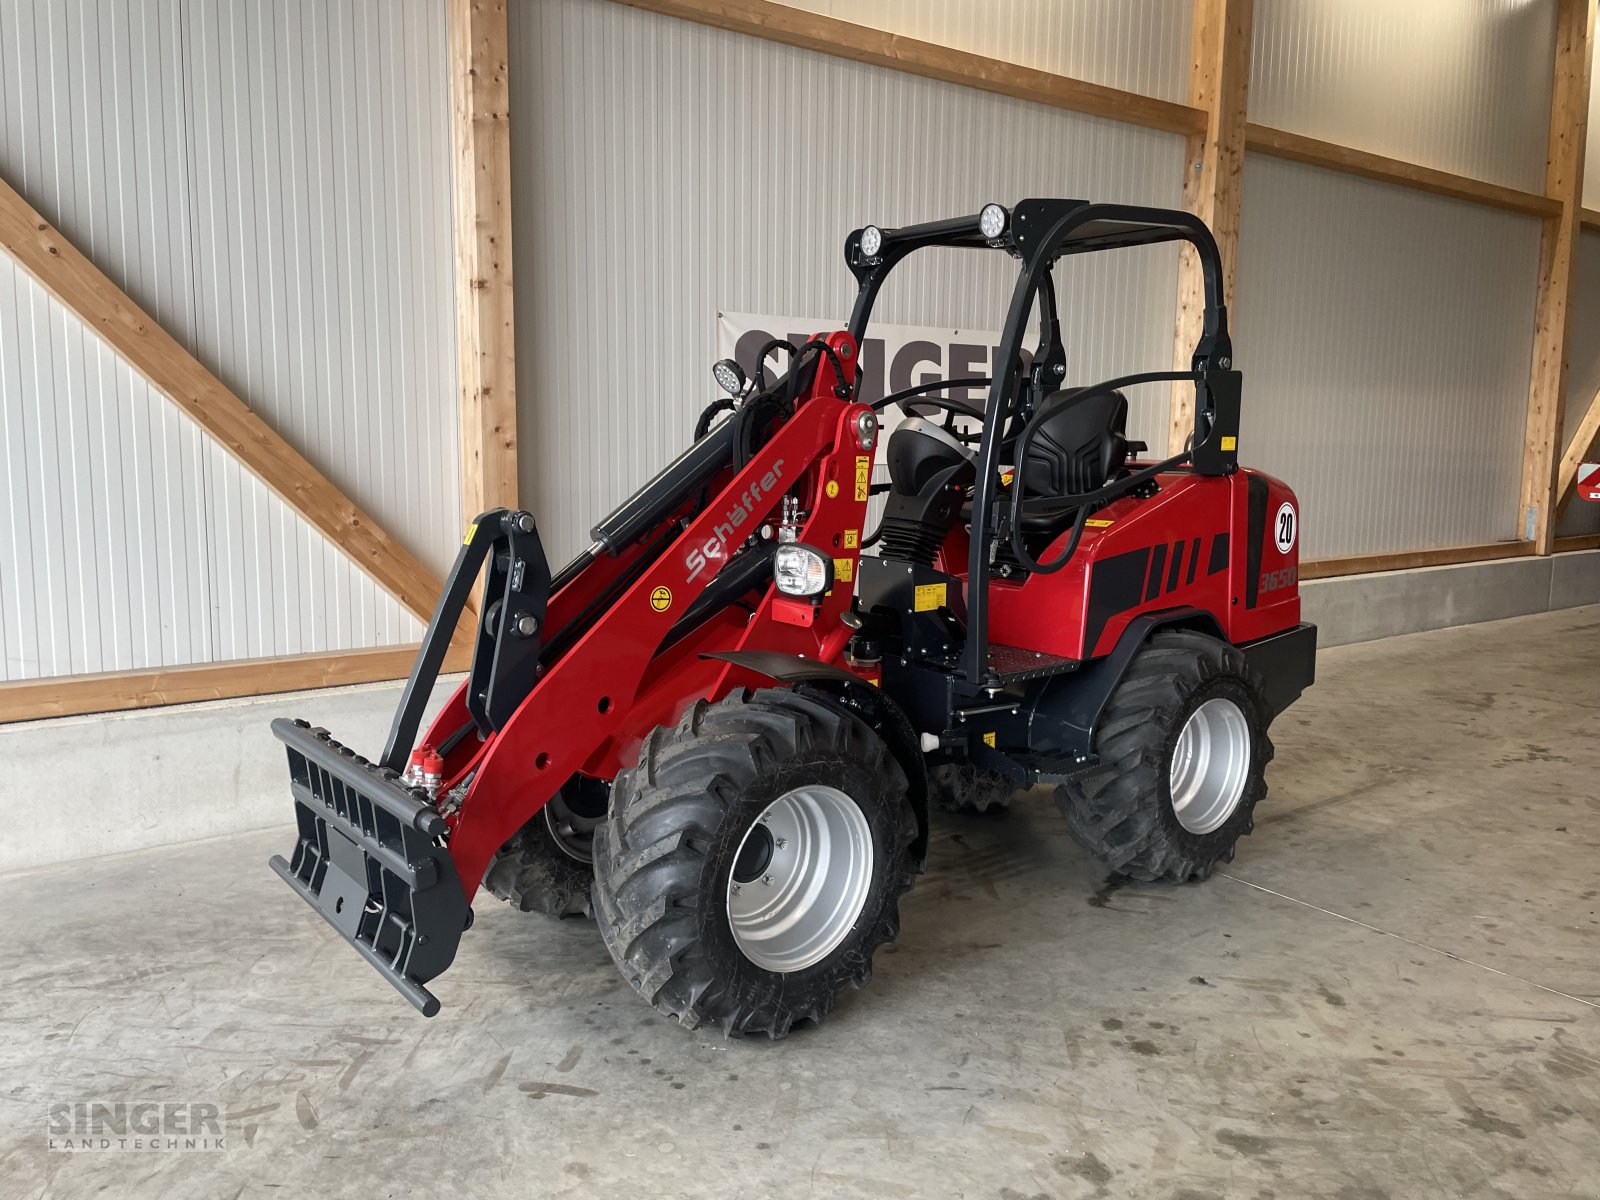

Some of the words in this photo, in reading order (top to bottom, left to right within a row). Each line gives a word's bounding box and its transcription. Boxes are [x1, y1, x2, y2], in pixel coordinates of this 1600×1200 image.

[735, 329, 1035, 417] SGE
[685, 459, 784, 584] Schäffer
[1279, 512, 1293, 544] 20
[1259, 566, 1297, 593] 3650
